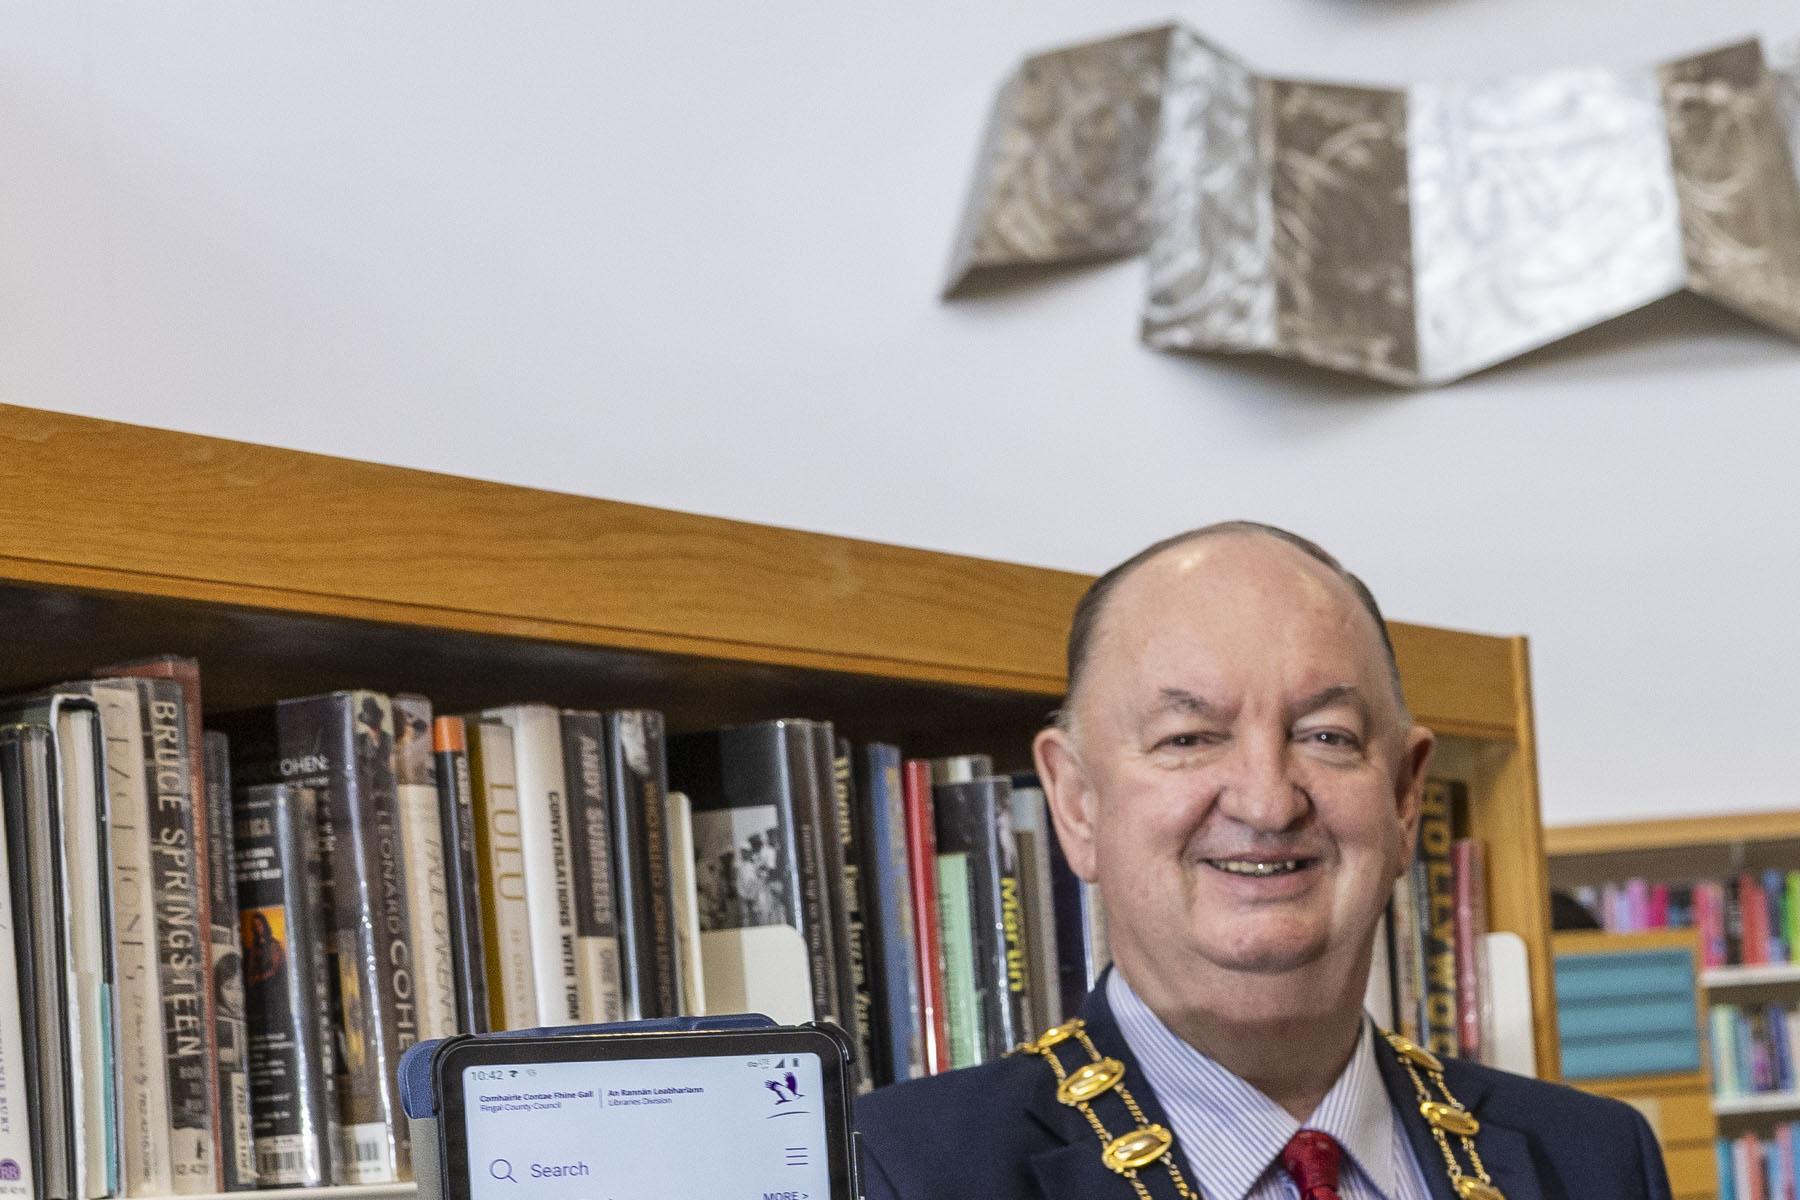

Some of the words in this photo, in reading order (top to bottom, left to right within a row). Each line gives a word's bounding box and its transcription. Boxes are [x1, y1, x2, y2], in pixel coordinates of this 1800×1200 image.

[150, 701, 190, 811] BRUCE
[579, 735, 601, 800] ANDY
[490, 782, 526, 901] LULU
[548, 792, 571, 927] CONVERSATIONS
[585, 806, 610, 924] SUMMERS
[159, 828, 203, 1057] SPRINGSTEEN
[376, 810, 402, 934] LEONARD
[390, 939, 416, 1050] COHE
[561, 934, 576, 977] WITH
[1000, 877, 1023, 992] Martin
[566, 984, 579, 1020] TOM
[472, 1070, 503, 1081] 10:42
[608, 1089, 619, 1097] An
[530, 1161, 589, 1179] Search
